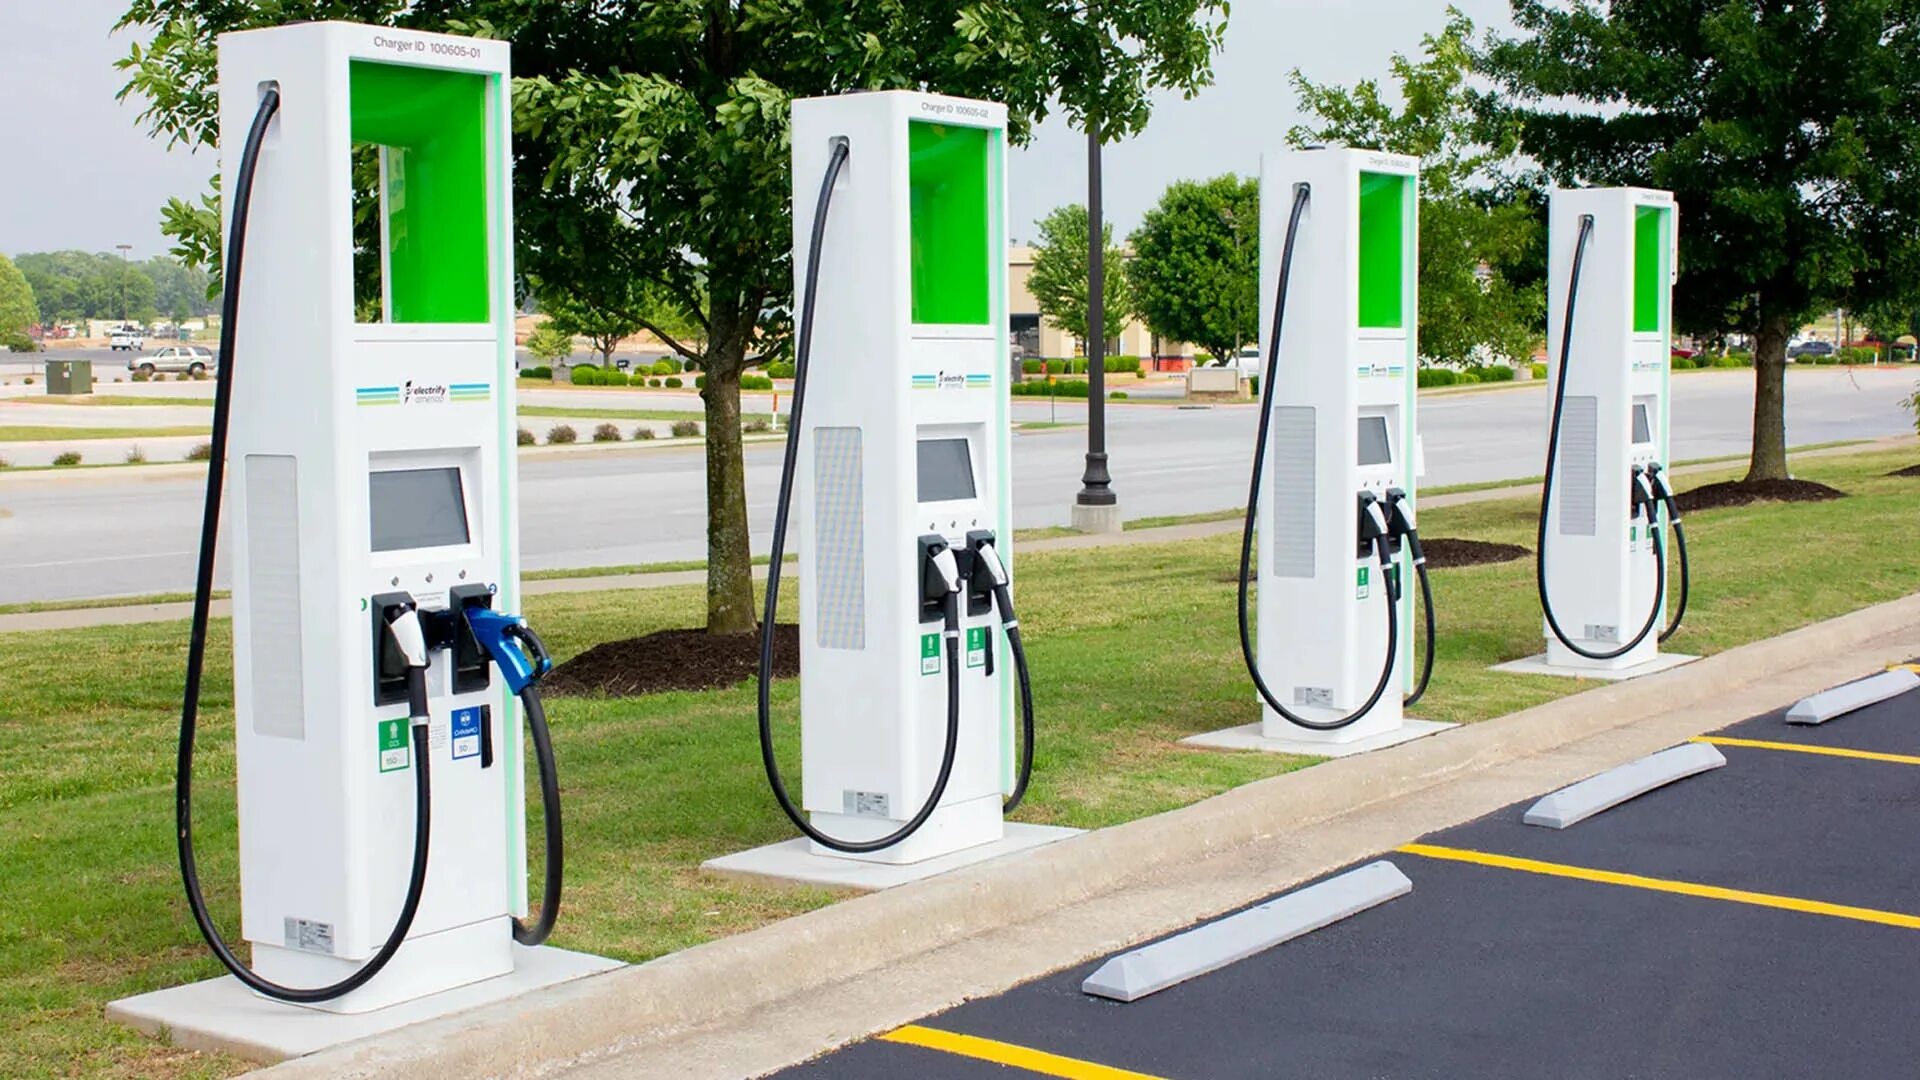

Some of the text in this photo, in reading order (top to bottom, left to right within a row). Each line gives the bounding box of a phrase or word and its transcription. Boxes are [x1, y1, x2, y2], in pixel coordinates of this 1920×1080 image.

[373, 36, 481, 58] Charger ID 100605-01
[413, 385, 446, 396] electrify
